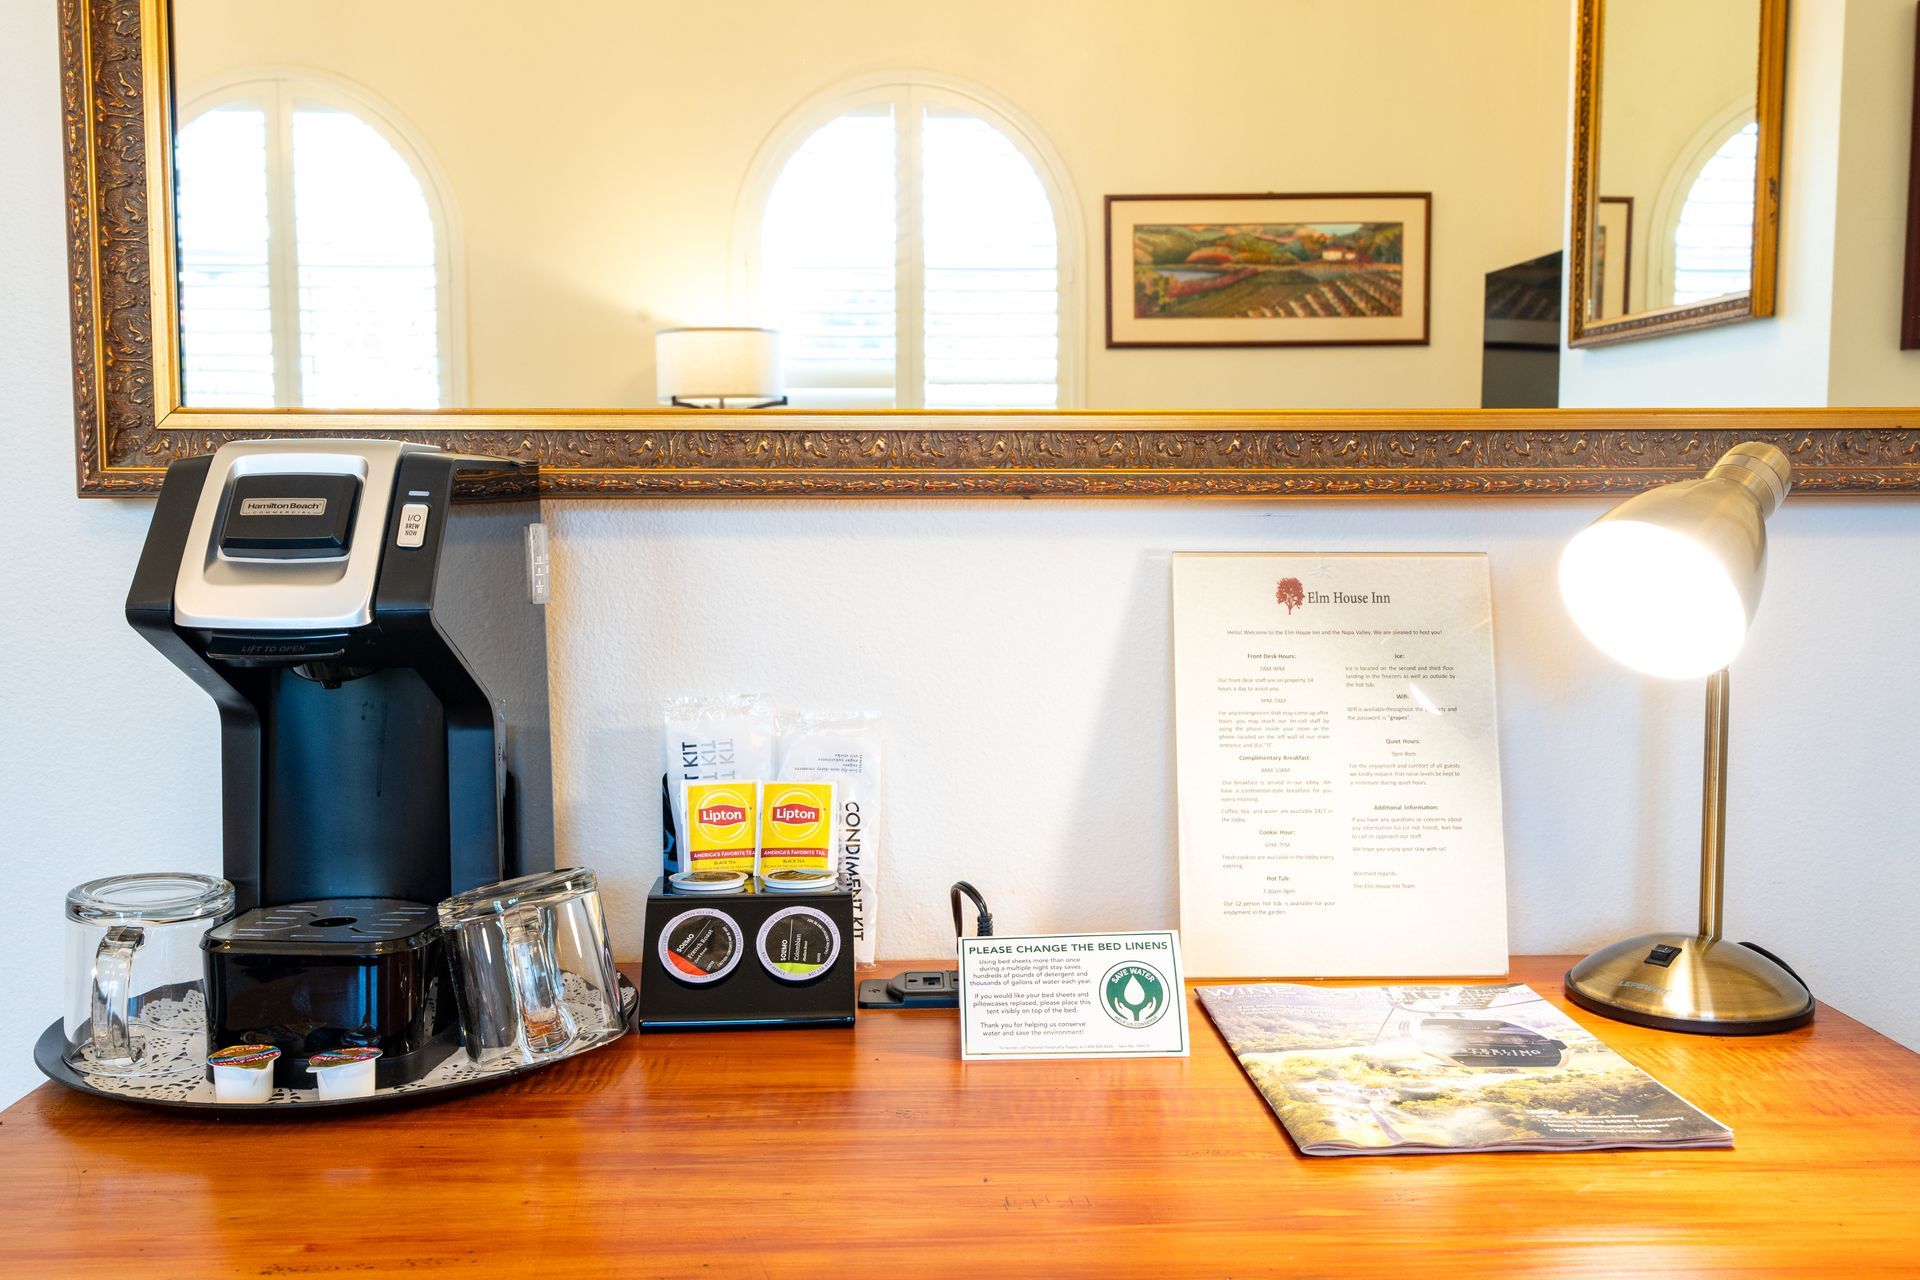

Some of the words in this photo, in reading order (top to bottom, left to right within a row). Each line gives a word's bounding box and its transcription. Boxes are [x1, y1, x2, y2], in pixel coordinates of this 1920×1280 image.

[1308, 592, 1330, 604] Elm
[1334, 592, 1368, 604] House
[1372, 592, 1391, 604] Inn
[682, 742, 698, 767] KIT
[702, 810, 742, 822] Lipton
[776, 808, 815, 822] Lipton
[846, 802, 862, 912] CONDIMENT
[853, 918, 864, 941] KIT
[687, 942, 703, 959] French
[701, 930, 713, 943] Roast
[969, 946, 1012, 954] PLEASE
[1016, 945, 1067, 953] CHANGE
[1126, 942, 1167, 950] LINENS
[1112, 968, 1129, 983] SAVE
[1130, 967, 1155, 982] WATER
[1205, 986, 1297, 997] WINE
[1115, 1015, 1126, 1023] HELP
[1134, 1015, 1158, 1026] CONSERVE
